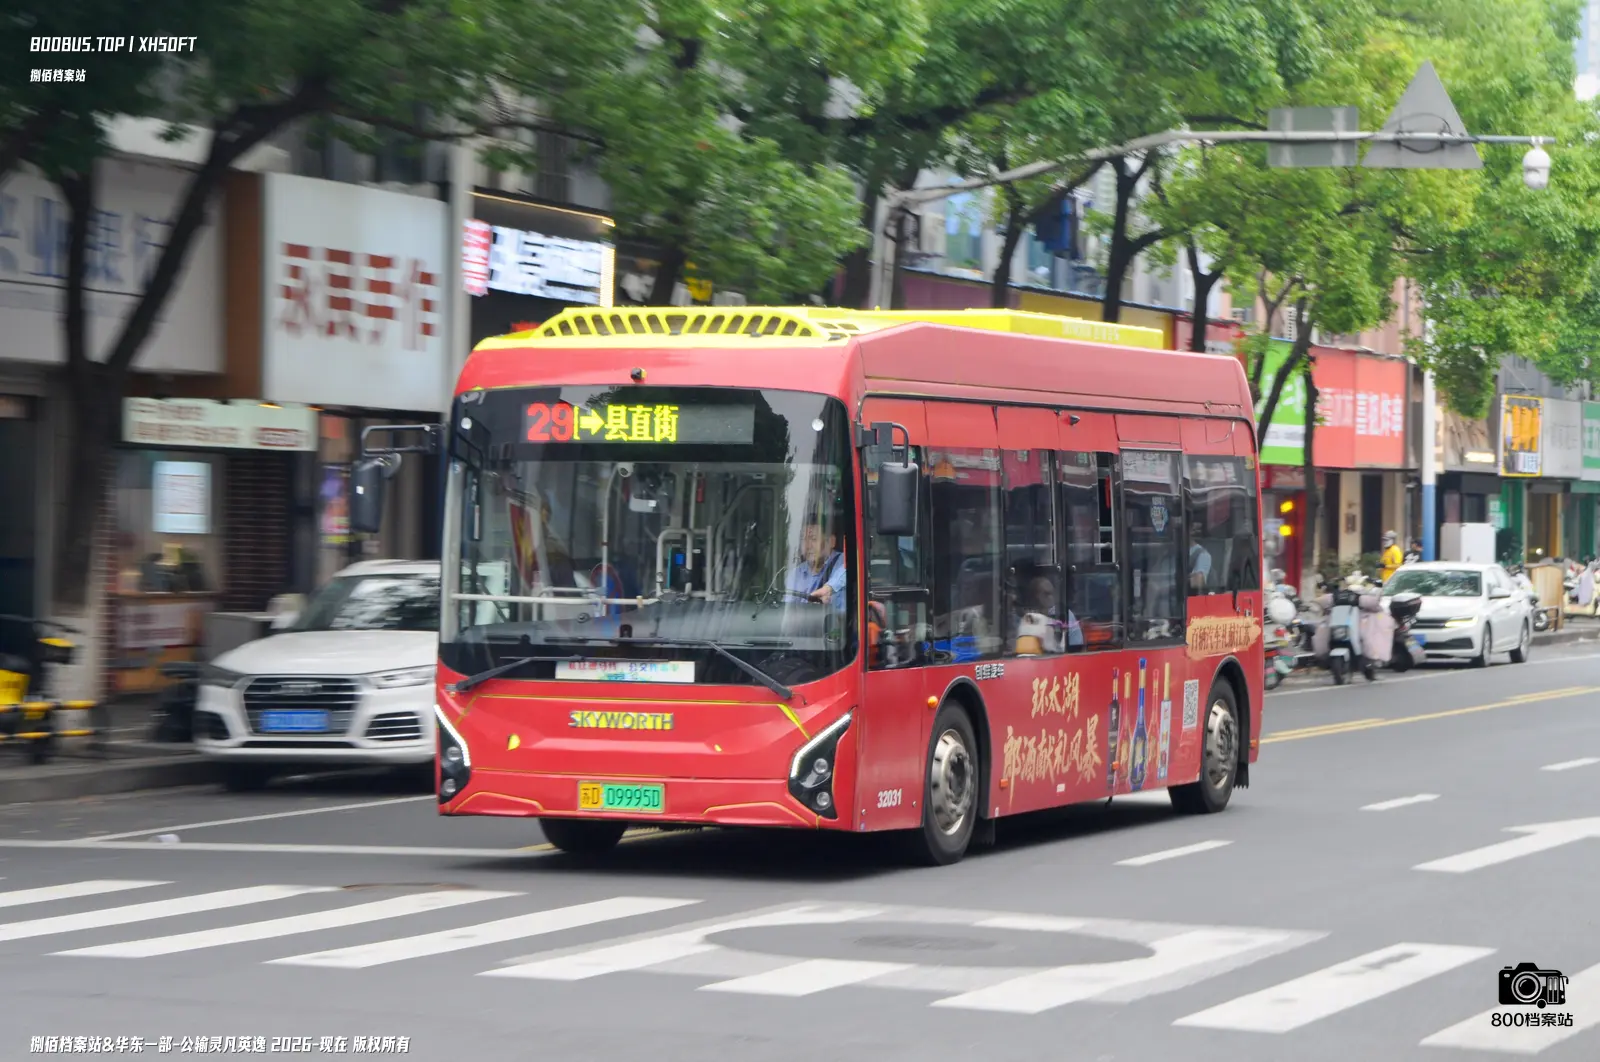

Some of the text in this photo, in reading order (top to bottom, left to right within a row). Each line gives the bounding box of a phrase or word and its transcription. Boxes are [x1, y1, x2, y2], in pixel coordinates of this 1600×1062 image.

[527, 403, 573, 441] 29
[604, 405, 679, 442] 县直街
[1031, 672, 1080, 723] 环太湖
[568, 710, 674, 730] SKYWORTH
[1003, 713, 1102, 800] 郎酒献礼风暴
[607, 788, 660, 807] 09995D
[877, 789, 902, 807] 32031
